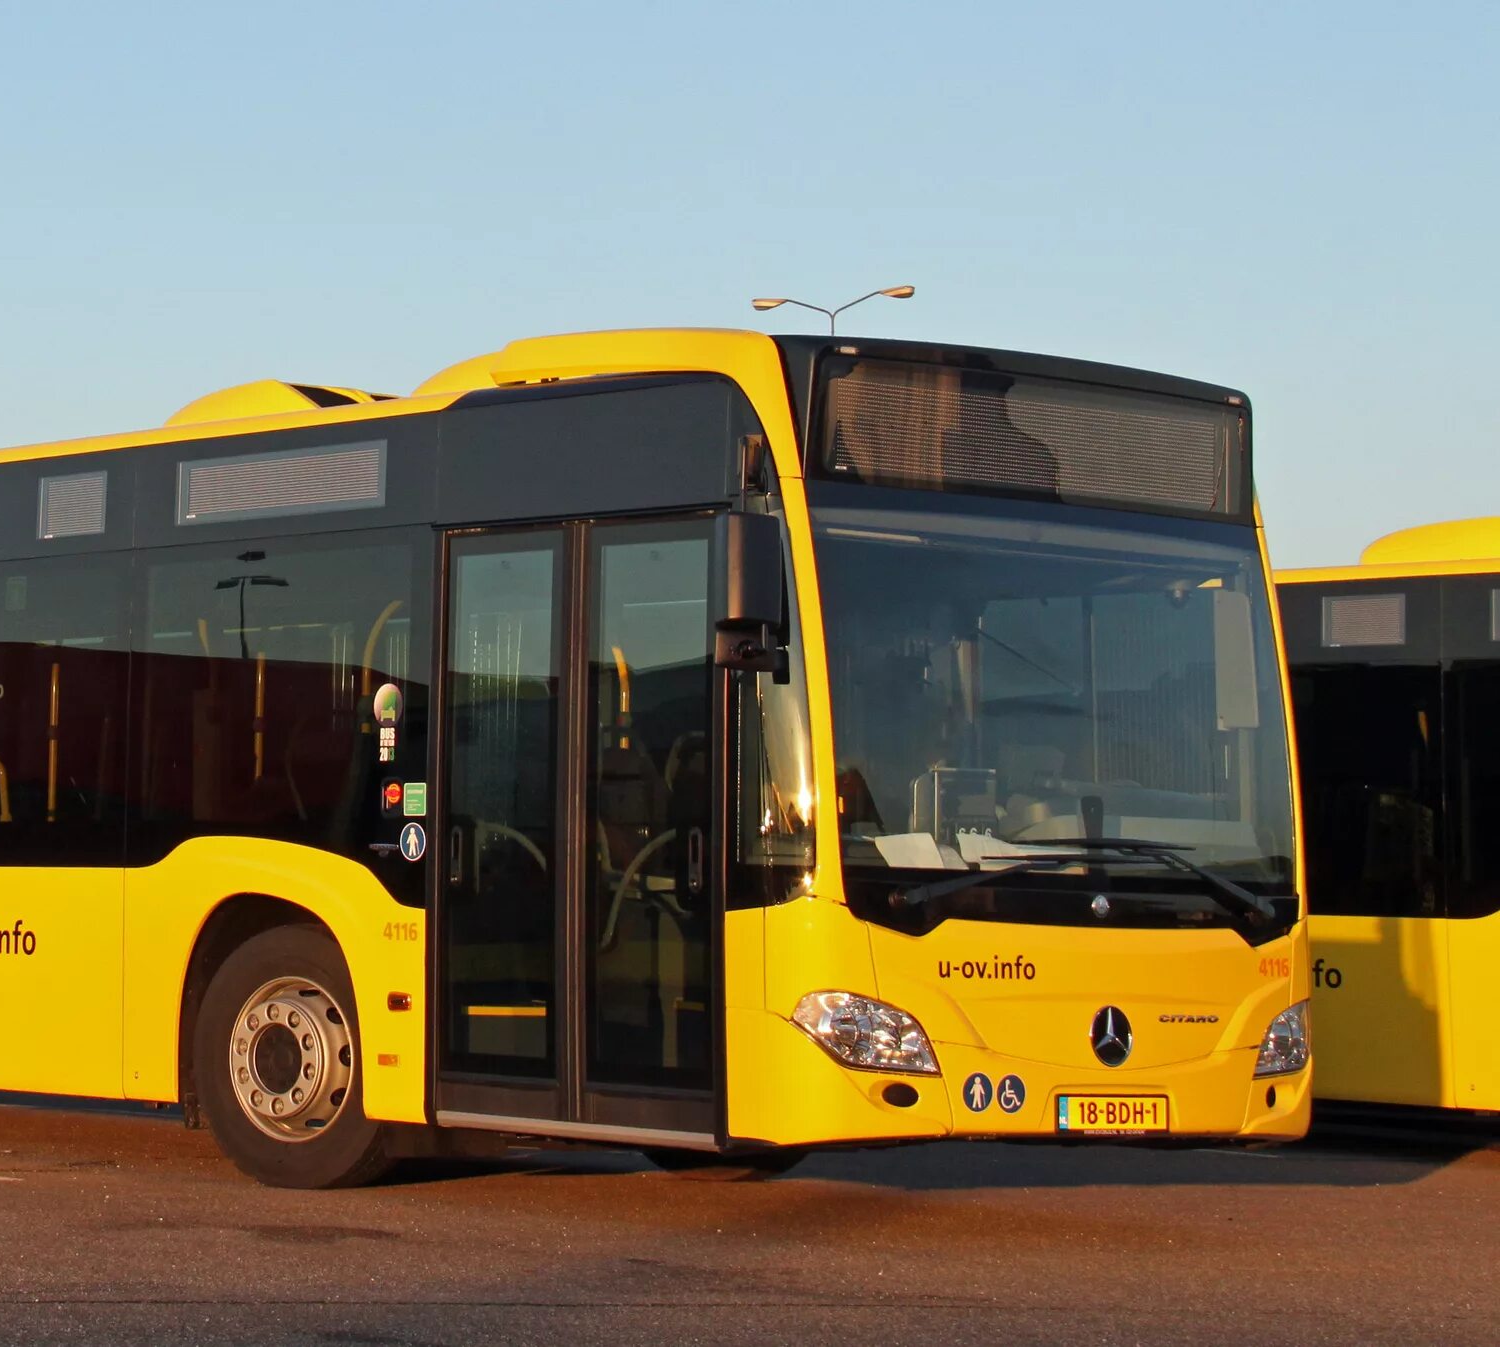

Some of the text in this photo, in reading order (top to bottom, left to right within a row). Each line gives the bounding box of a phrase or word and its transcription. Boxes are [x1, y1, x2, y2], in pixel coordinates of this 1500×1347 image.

[380, 727, 395, 740] BUS
[379, 746, 395, 762] 2013
[383, 921, 418, 942] 4116
[938, 954, 1036, 980] u-ov.info
[1259, 957, 1290, 978] 4116
[1158, 1014, 1219, 1024] CITARO
[1058, 1116, 1068, 1125] NL
[1079, 1101, 1157, 1125] 18-BDH-1
